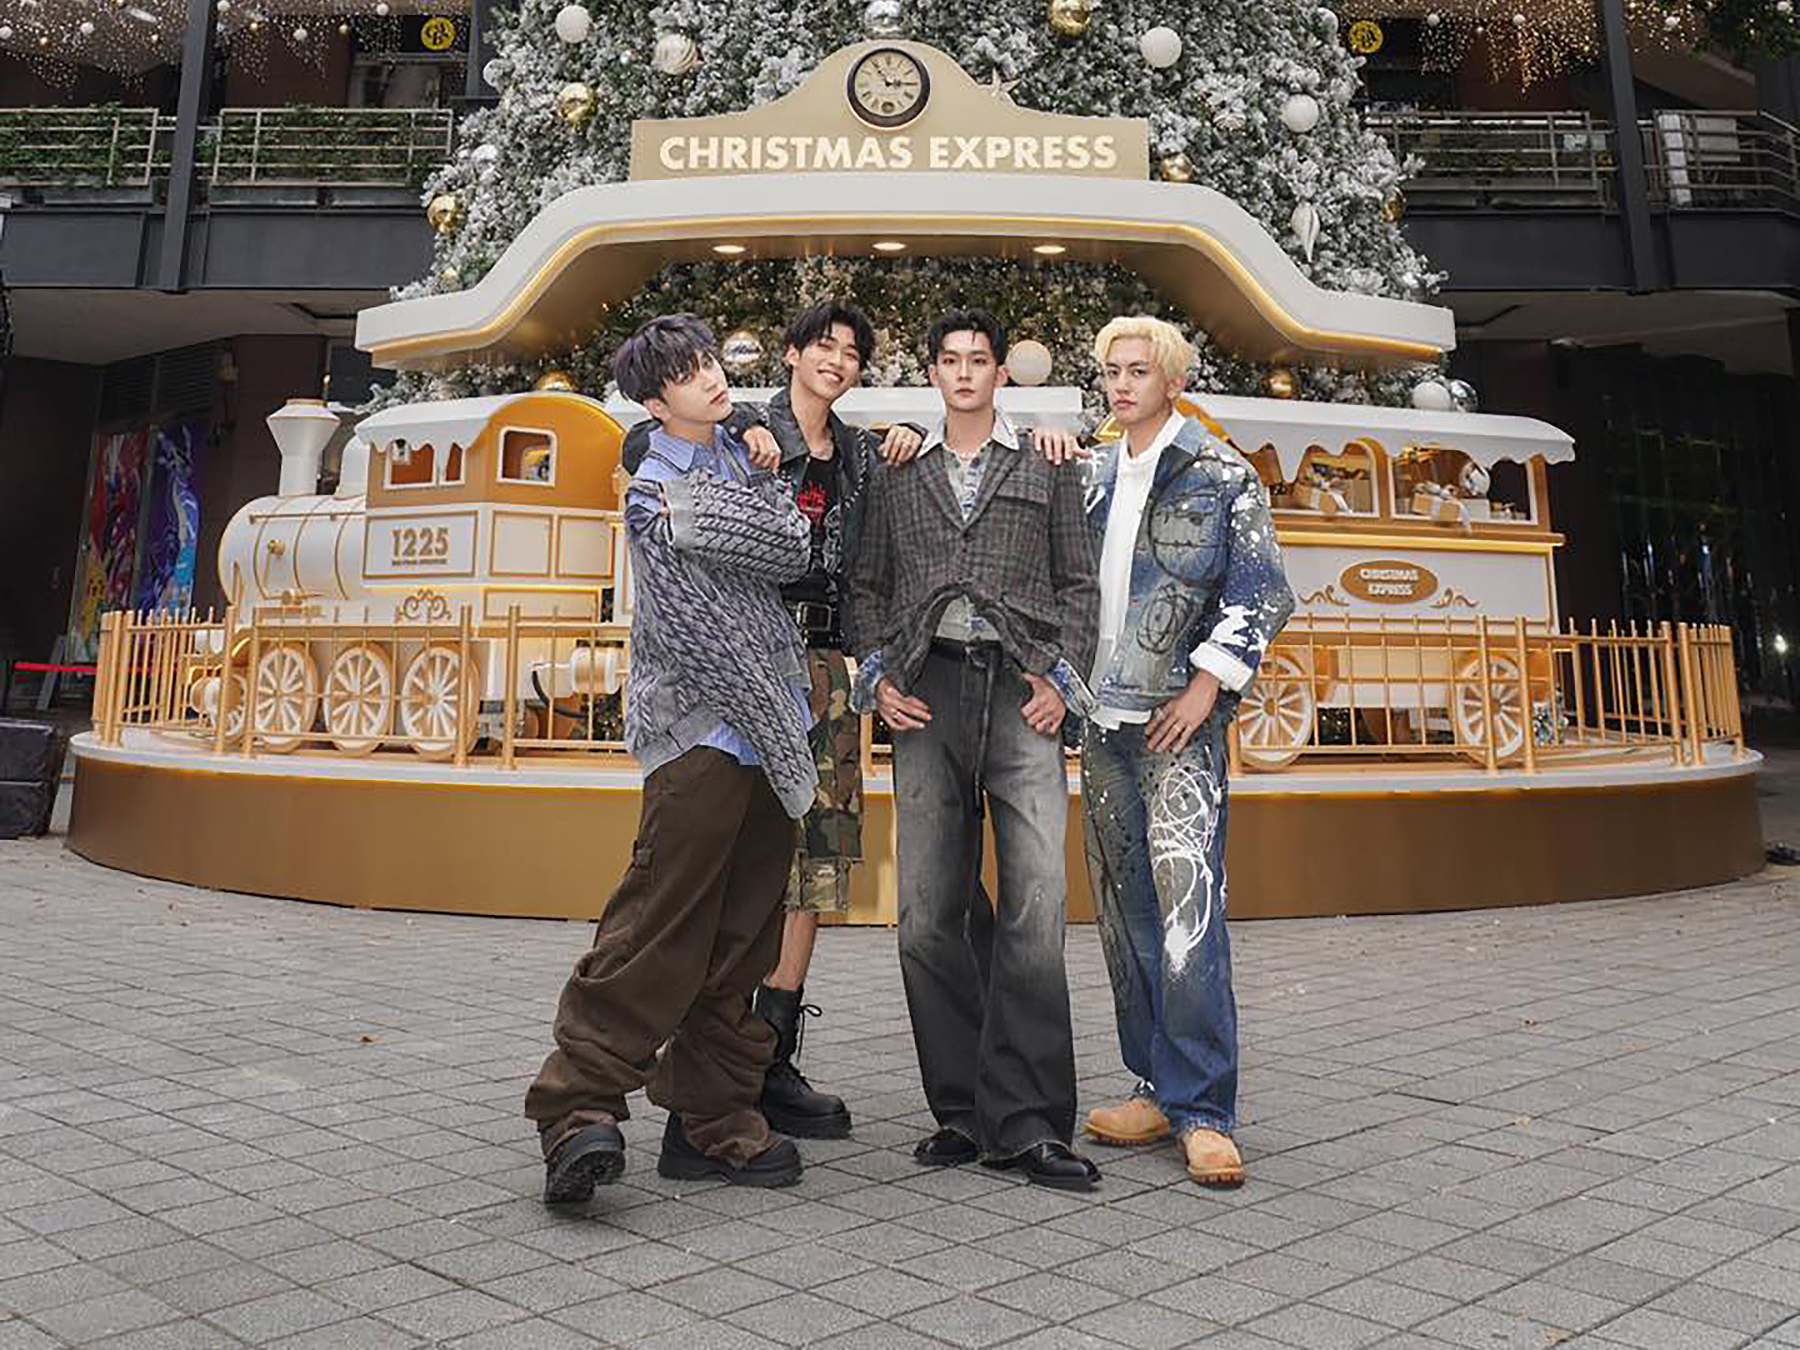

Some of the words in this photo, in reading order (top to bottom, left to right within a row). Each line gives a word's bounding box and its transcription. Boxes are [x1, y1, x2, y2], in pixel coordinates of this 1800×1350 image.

[659, 136, 914, 171] CHRISTMAS
[929, 135, 1119, 170] EXPRESS
[391, 527, 449, 557] 1225
